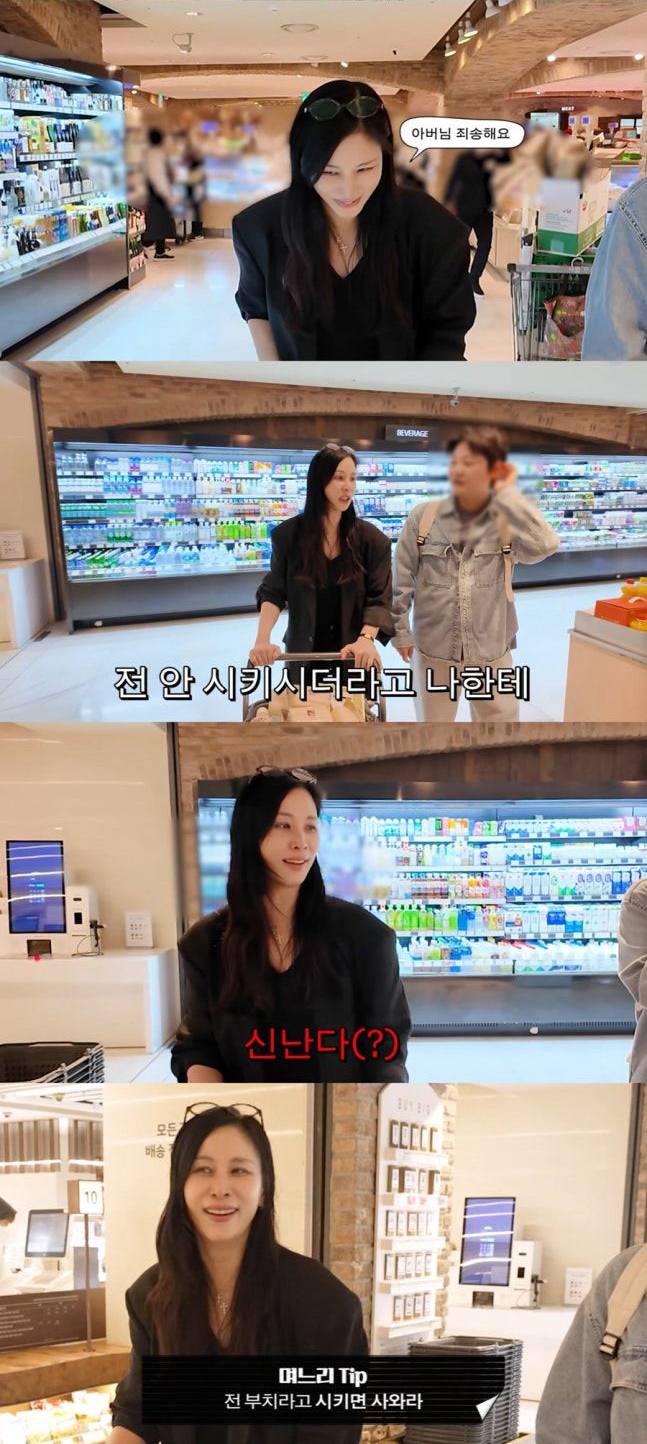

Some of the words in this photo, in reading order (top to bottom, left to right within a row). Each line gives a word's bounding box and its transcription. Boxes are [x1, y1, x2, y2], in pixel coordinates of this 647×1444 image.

[396, 429, 429, 438] BEVERAGE
[156, 1122, 177, 1137] 모든
[145, 1144, 165, 1159] 배송
[84, 1190, 98, 1205] 10
